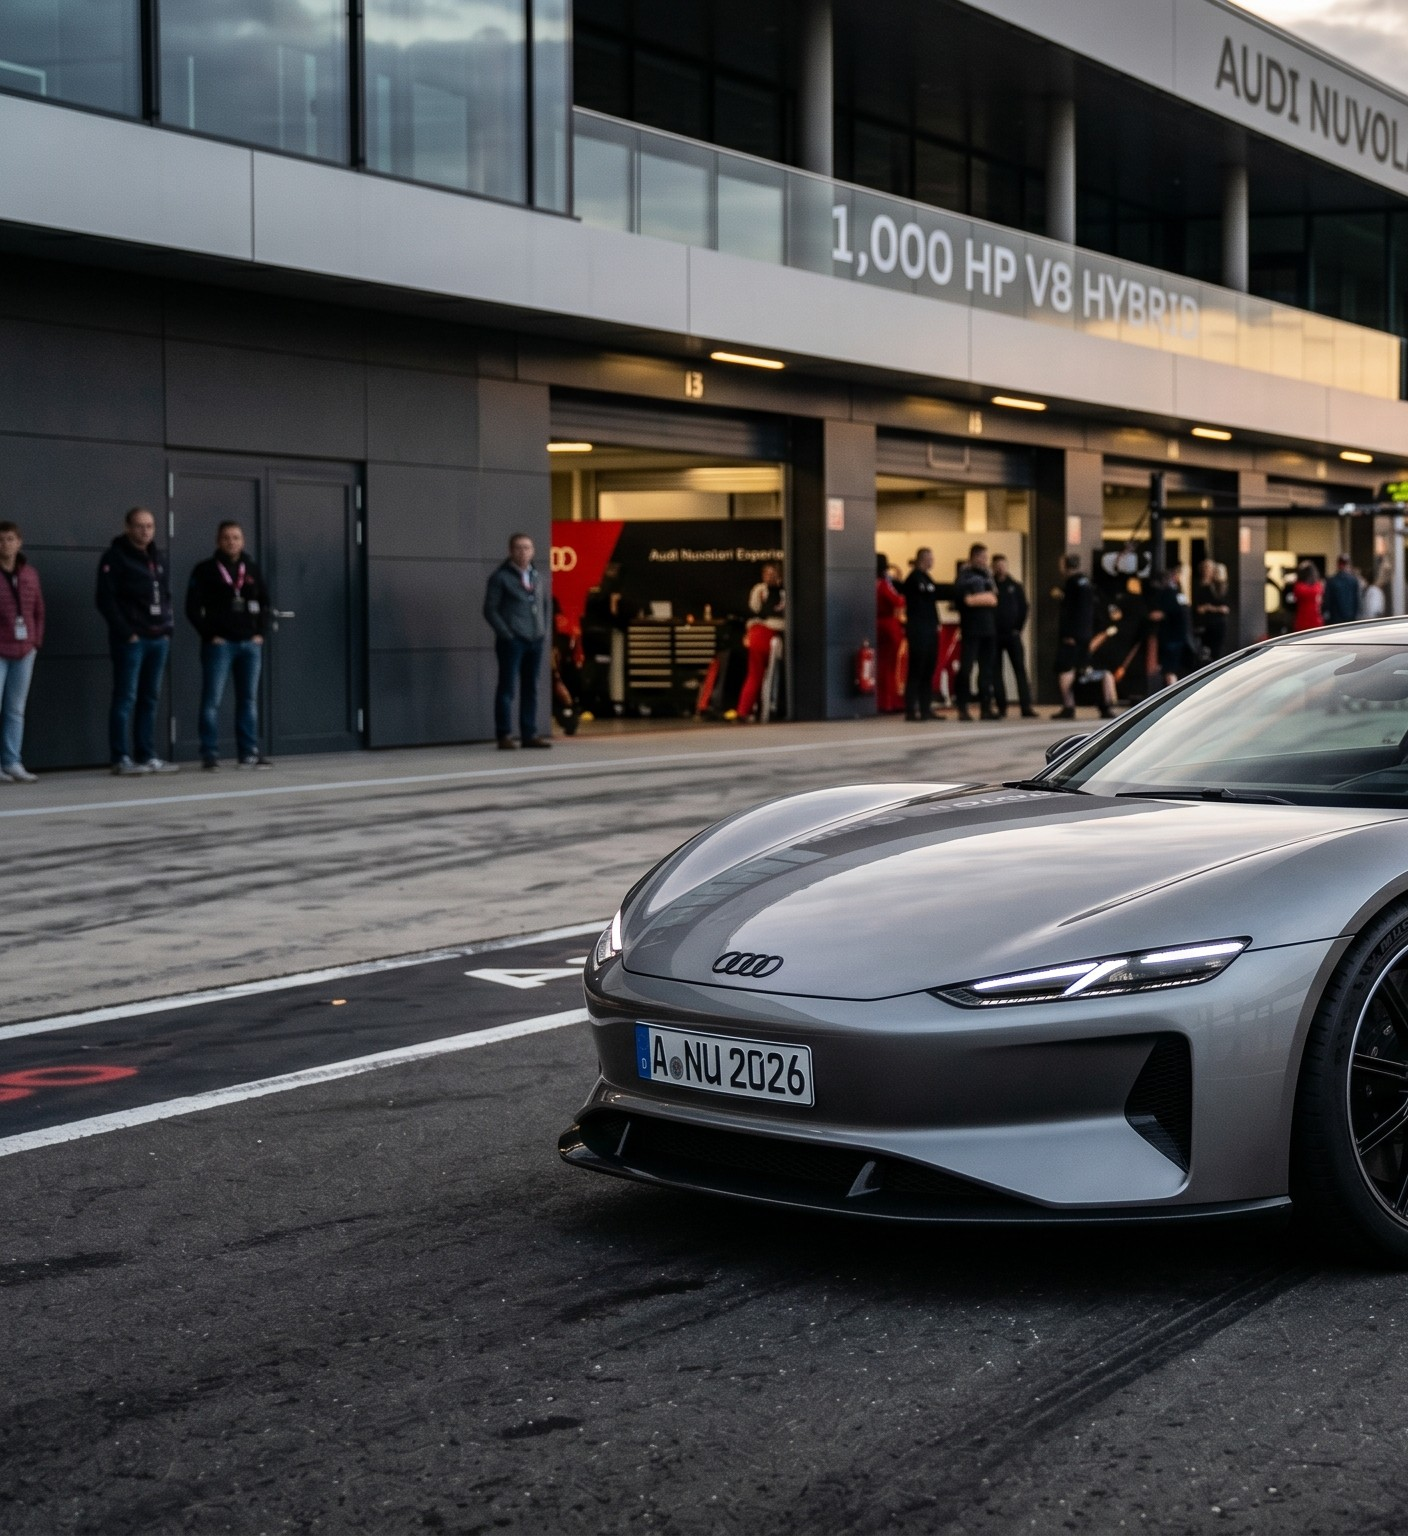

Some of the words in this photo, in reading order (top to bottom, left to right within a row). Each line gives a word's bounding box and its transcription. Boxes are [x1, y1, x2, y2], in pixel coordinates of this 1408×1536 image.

[1215, 36, 1299, 125] AUDI
[831, 204, 953, 286] 1,000
[964, 238, 1018, 298] HP
[1025, 253, 1074, 314] V8
[1082, 269, 1200, 341] HYBRID
[653, 1034, 669, 1077] A
[684, 1039, 722, 1086] NU
[729, 1047, 806, 1096] 2026
